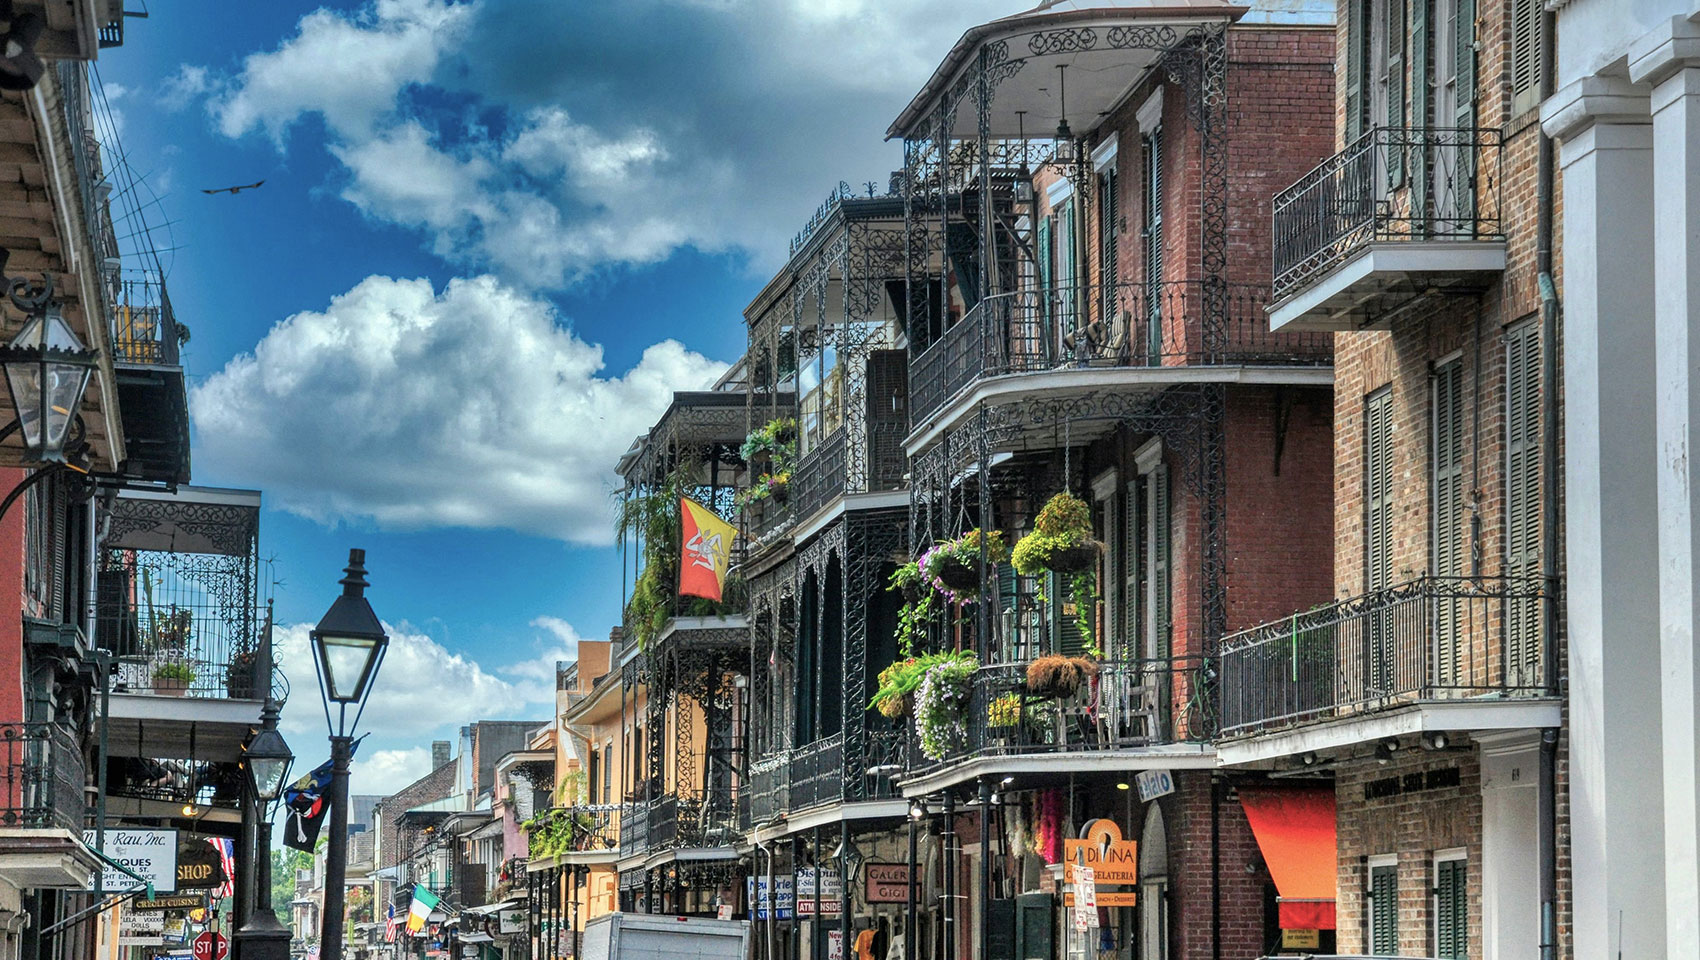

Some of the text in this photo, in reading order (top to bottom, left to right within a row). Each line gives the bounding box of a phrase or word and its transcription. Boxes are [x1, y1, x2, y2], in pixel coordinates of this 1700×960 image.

[144, 832, 166, 846] Inc.
[177, 864, 213, 880] SHOP
[879, 887, 905, 898] GIGI
[799, 902, 815, 911] ATM
[819, 902, 842, 911] NSIDE
[196, 941, 226, 954] STP
